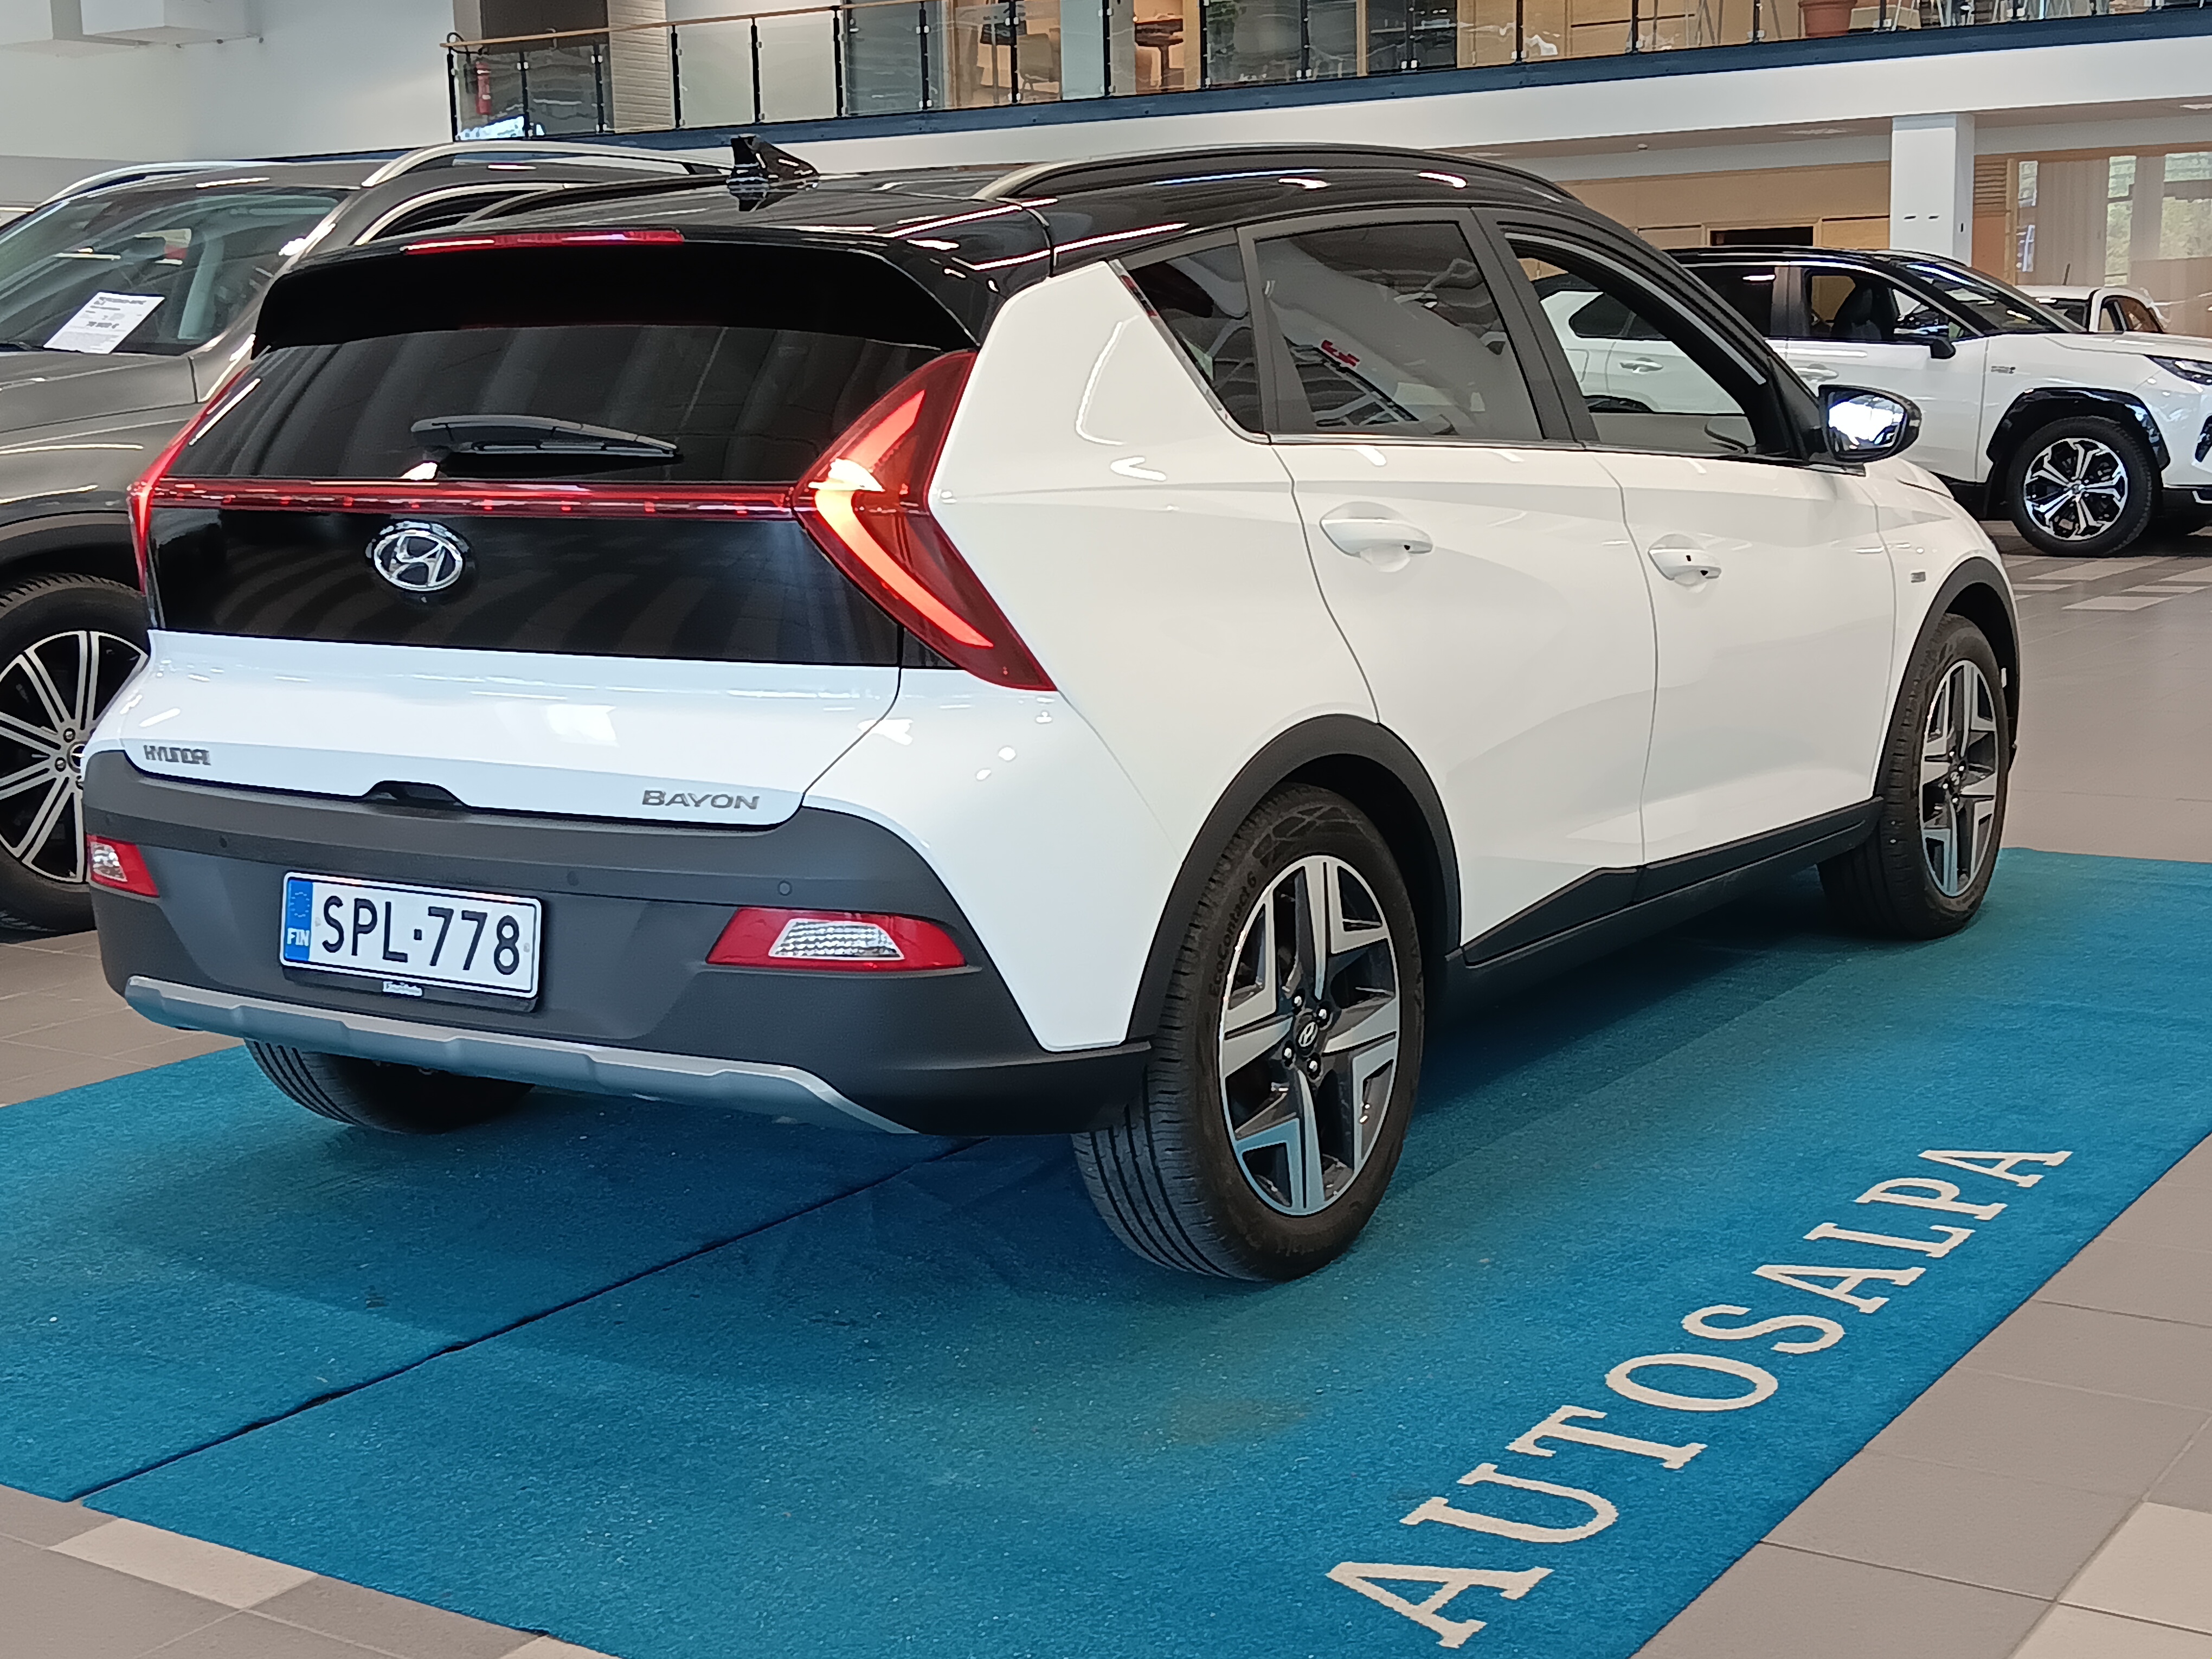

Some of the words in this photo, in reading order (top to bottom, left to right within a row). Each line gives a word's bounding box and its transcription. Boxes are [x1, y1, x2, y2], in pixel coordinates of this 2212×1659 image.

[642, 790, 760, 809] BAYON
[286, 928, 310, 947] FIN
[1326, 1150, 2072, 1648] AUTOSALPA
